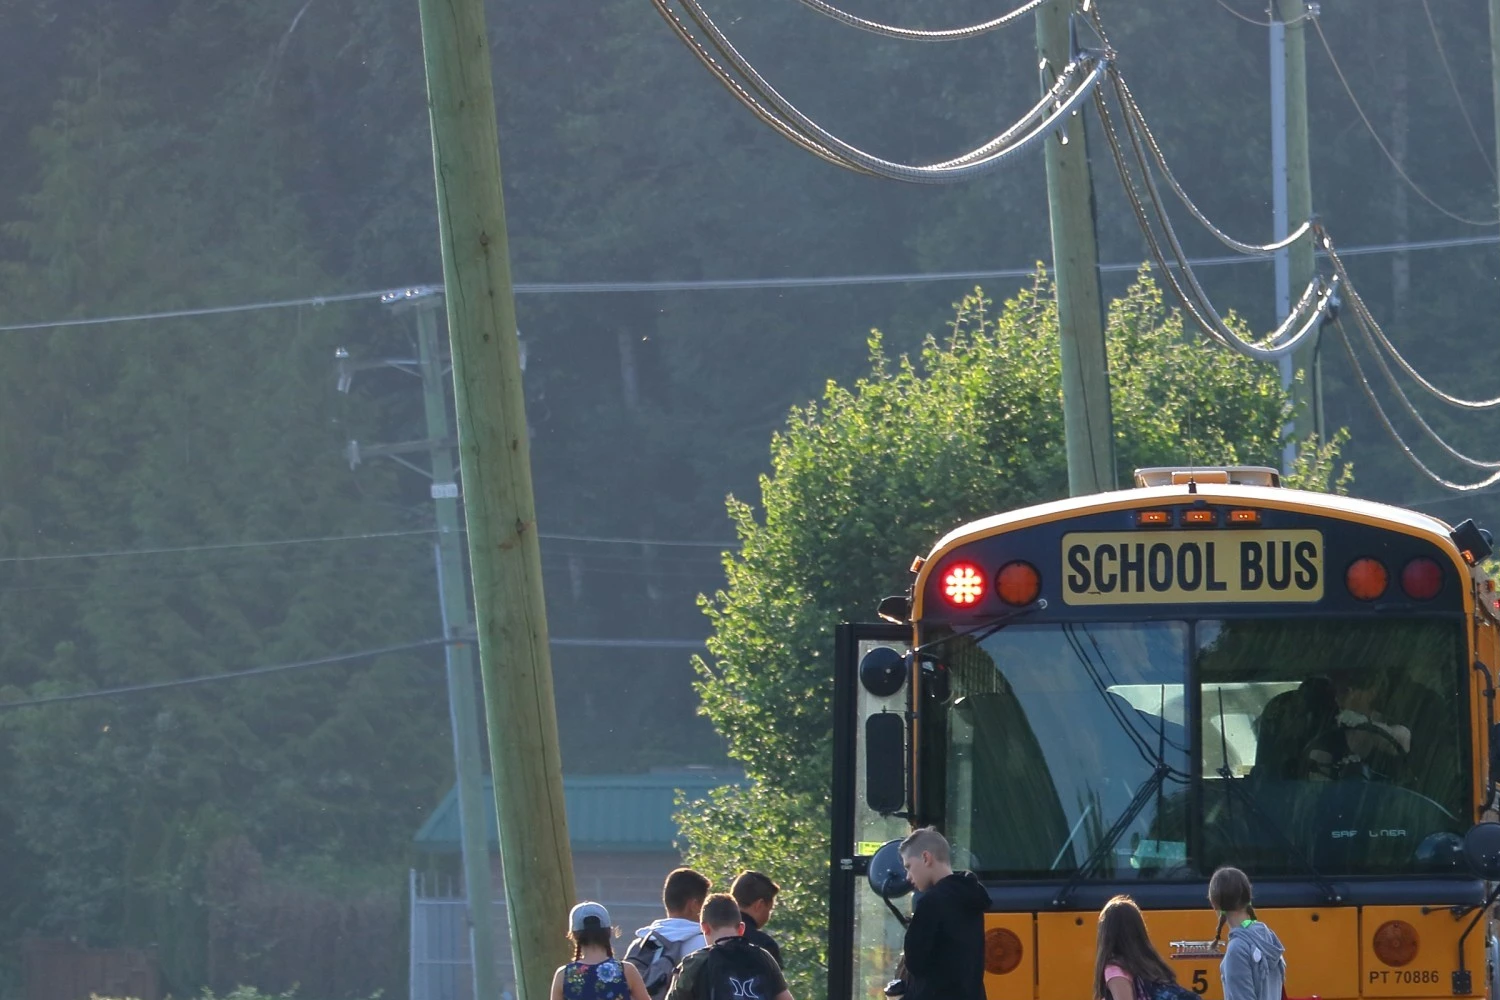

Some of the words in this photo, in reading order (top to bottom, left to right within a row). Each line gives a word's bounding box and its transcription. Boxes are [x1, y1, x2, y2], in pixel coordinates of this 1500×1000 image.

[1067, 542, 1227, 594] SCHOOL
[1240, 540, 1318, 591] BUS
[1191, 969, 1209, 995] 5
[1369, 971, 1389, 984] PT
[1395, 970, 1439, 983] 70886
